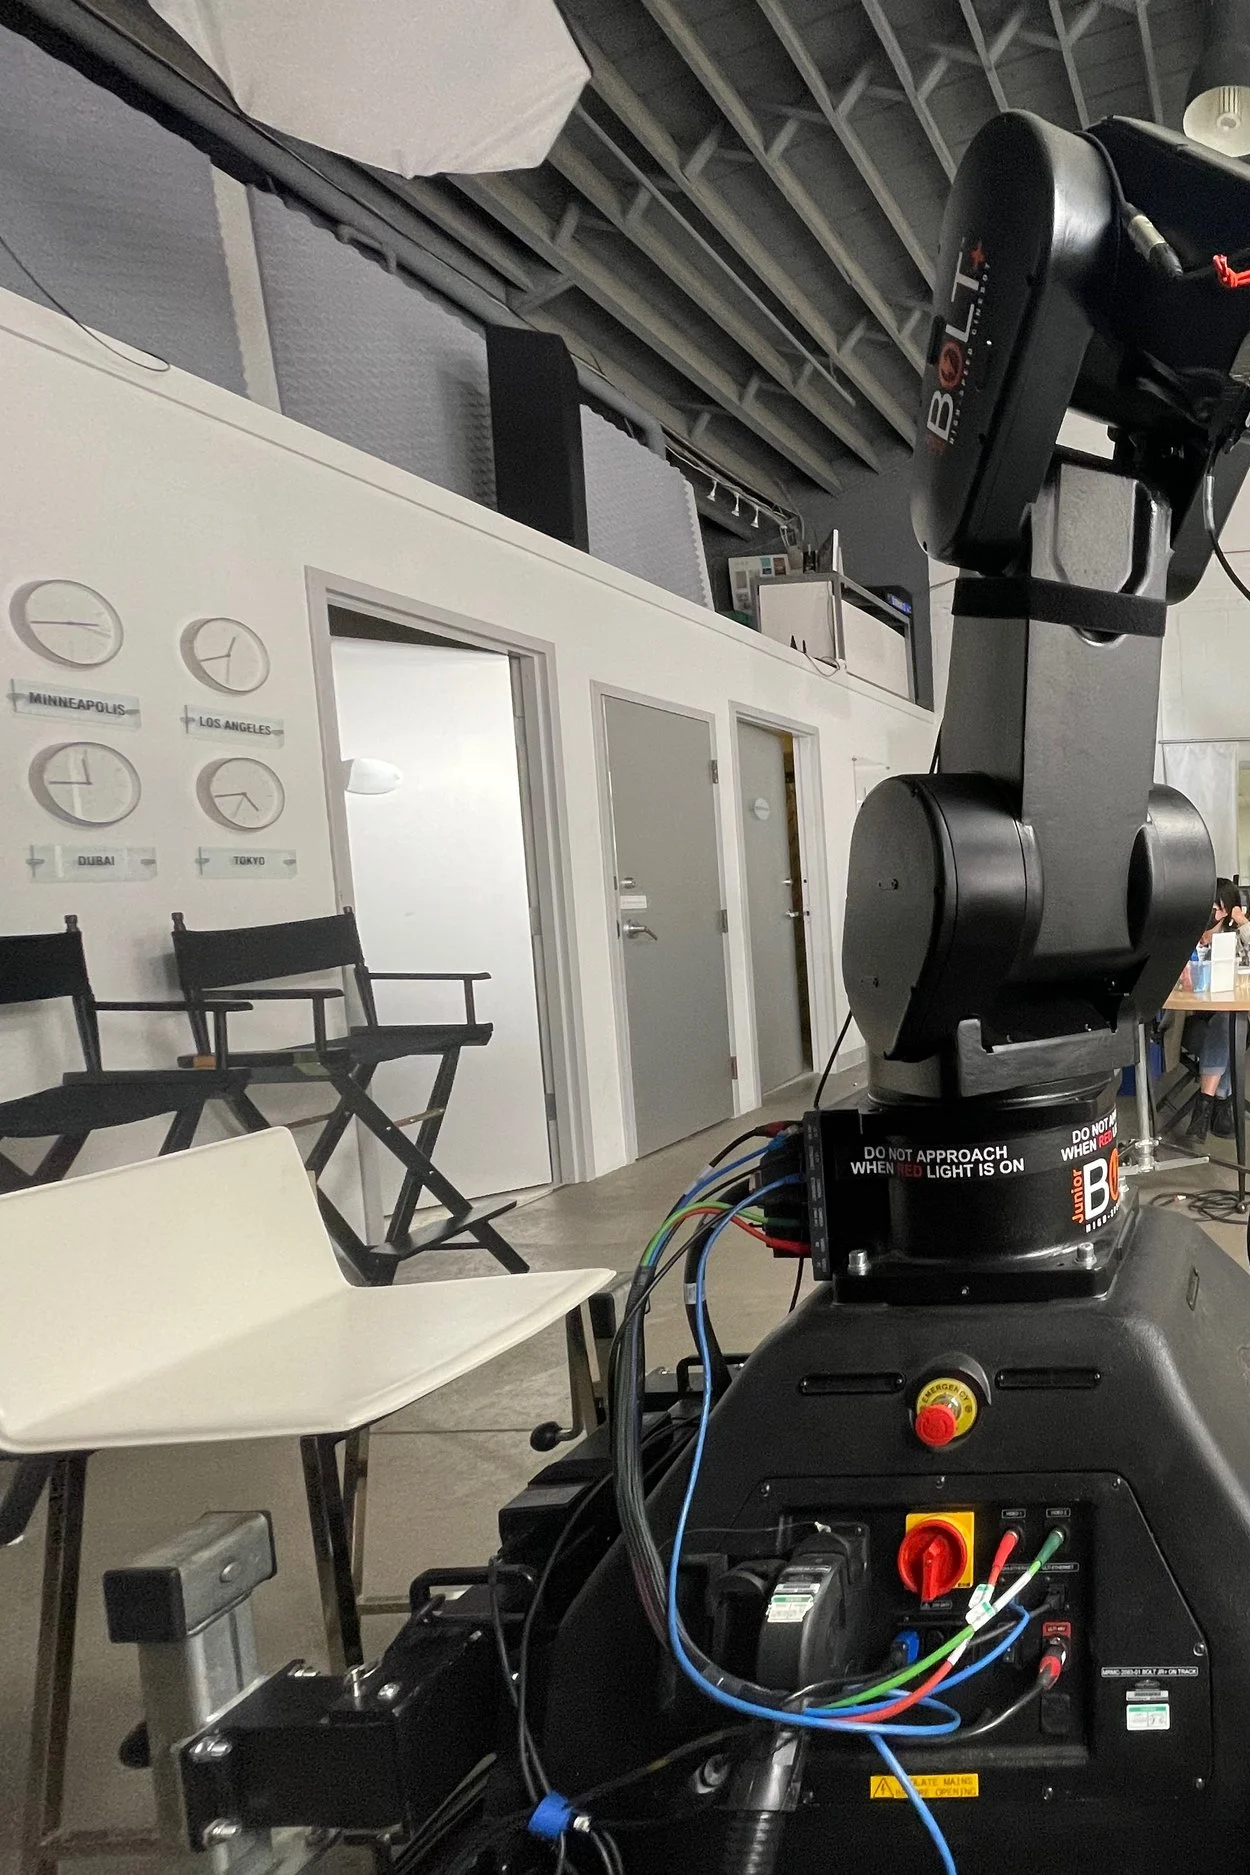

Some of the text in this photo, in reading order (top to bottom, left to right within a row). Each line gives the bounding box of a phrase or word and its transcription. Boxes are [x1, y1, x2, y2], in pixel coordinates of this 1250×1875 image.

[28, 691, 126, 716] MINNEAPOLIS
[199, 716, 272, 736] LOS ANGELES
[78, 855, 115, 867] DUBAI
[233, 855, 265, 867] TOKYO
[1072, 1127, 1090, 1144] DO
[1092, 1117, 1109, 1137] NOT
[864, 1145, 1008, 1164] DO NOT APPROACH
[1061, 1138, 1097, 1162] WHEN
[1097, 1130, 1113, 1148] RED
[850, 1158, 1025, 1179] WHEN RED LIGHT IS ON
[1072, 1169, 1084, 1224] Junior
[922, 1383, 970, 1403] EMERGENCY
[943, 1777, 973, 1786] MAINS
